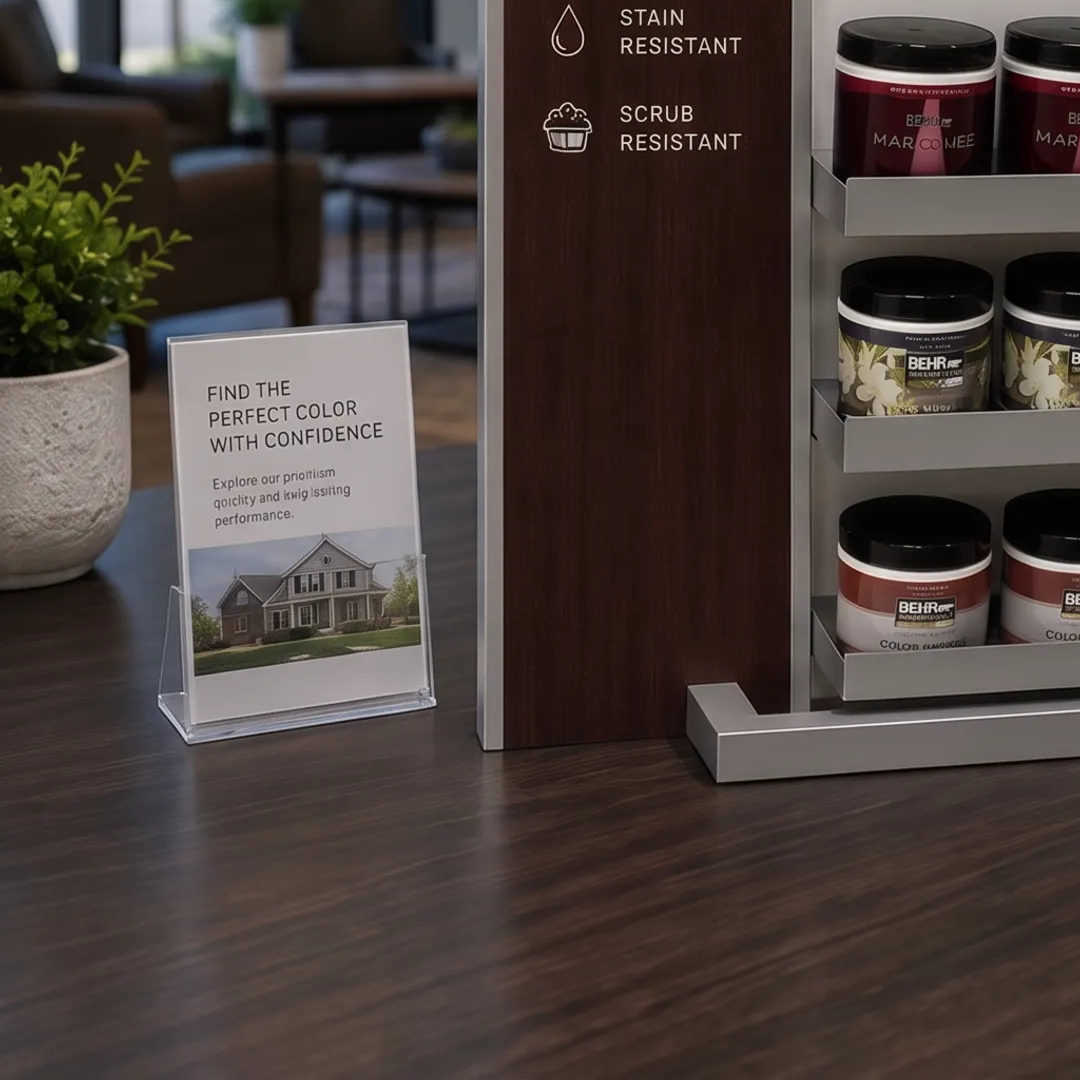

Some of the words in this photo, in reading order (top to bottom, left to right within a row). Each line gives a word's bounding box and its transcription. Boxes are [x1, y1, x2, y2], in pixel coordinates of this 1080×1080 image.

[620, 8, 684, 27] STAIN
[620, 36, 742, 55] RESISTANT
[620, 105, 694, 123] SCRUB
[620, 133, 742, 152] RESISTANT
[908, 356, 947, 370] BEHR
[207, 383, 250, 403] FIND
[255, 379, 291, 398] THE
[209, 406, 291, 428] PERFECT
[296, 400, 357, 421] COLOR
[209, 433, 258, 454] WITH
[264, 422, 384, 449] CONFIDENCE
[212, 476, 259, 491] Explore
[260, 474, 281, 487] our
[259, 490, 281, 505] and
[214, 508, 296, 530] performance.
[899, 601, 938, 613] BEHR
